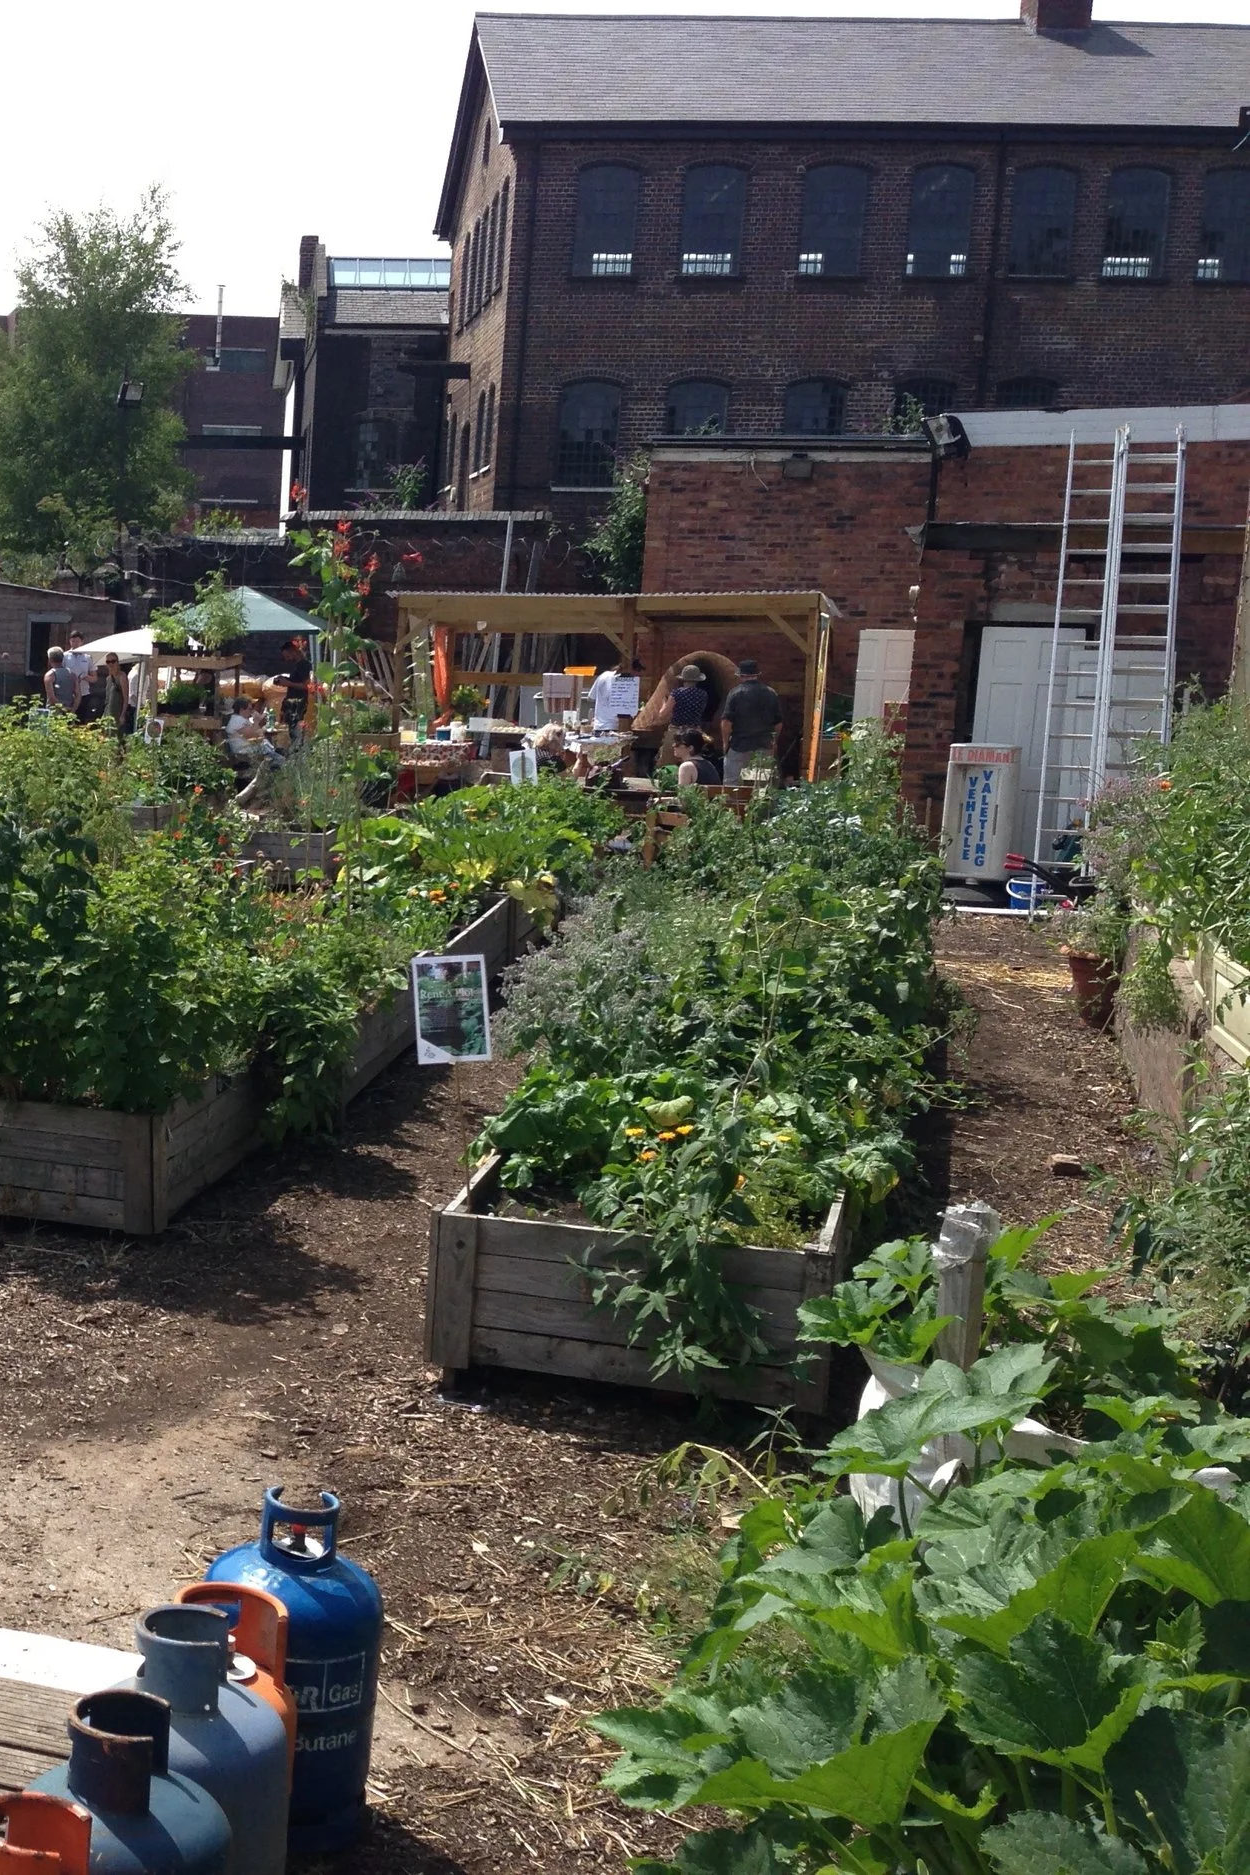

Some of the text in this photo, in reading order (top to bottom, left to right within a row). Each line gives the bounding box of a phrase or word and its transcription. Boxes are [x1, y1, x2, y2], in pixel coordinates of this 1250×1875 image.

[962, 777, 978, 860] VEHICLE
[974, 770, 993, 866] VALETING
[329, 1683, 358, 1703] Gas
